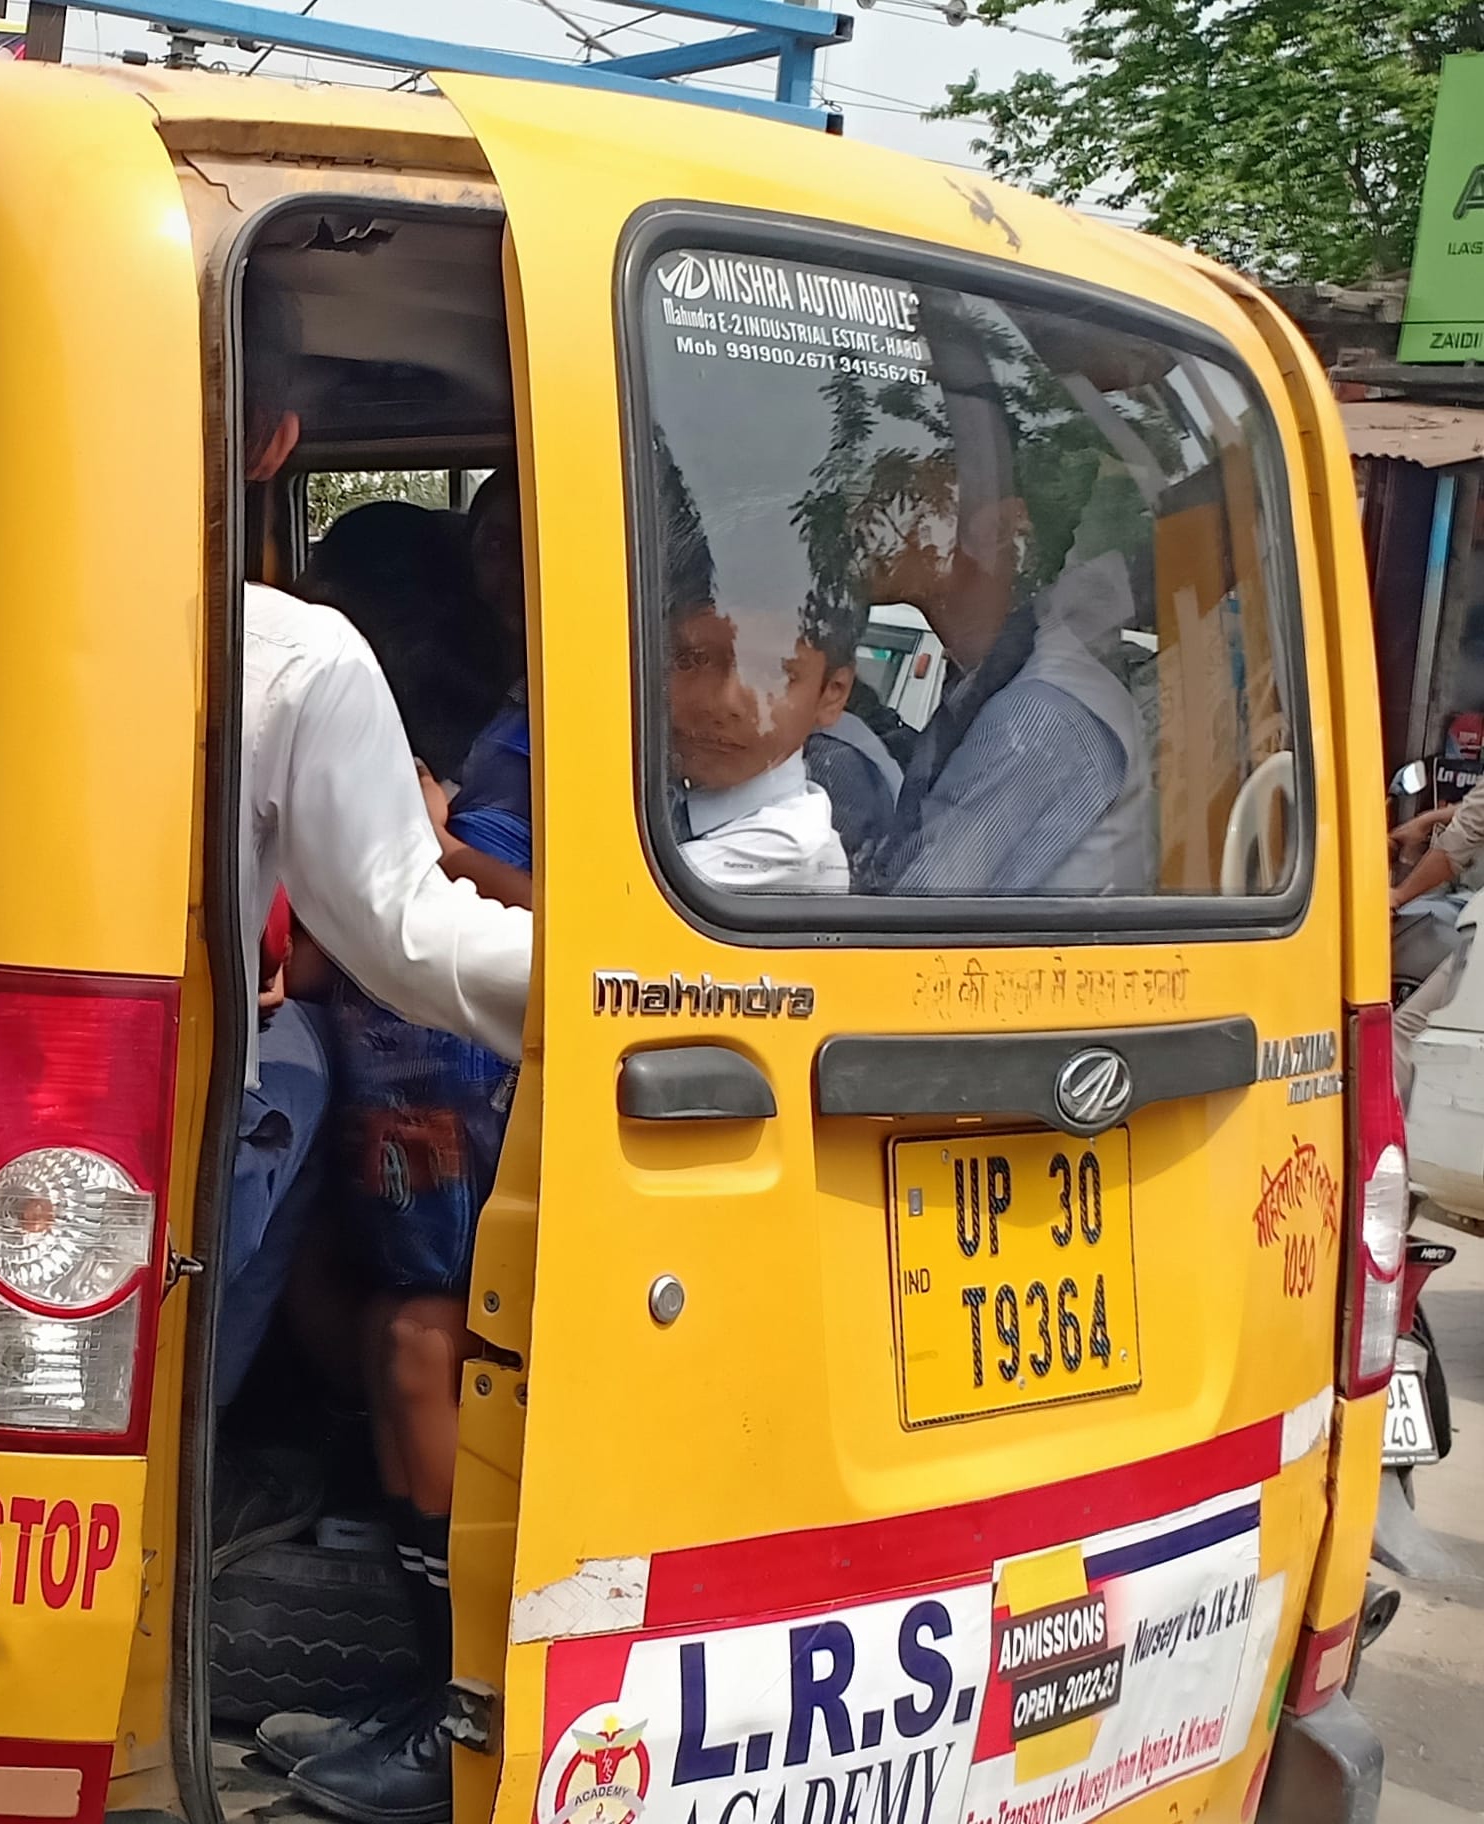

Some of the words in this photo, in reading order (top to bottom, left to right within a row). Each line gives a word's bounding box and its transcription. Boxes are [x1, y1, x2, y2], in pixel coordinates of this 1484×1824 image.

[662, 297, 717, 330] Mahindra
[708, 258, 794, 310] MISHRA
[592, 970, 816, 1020] Mahindra
[954, 1156, 1012, 1258] UP
[1048, 1150, 1103, 1248] 30
[903, 1268, 931, 1296] IND
[962, 1273, 1112, 1388] T9364
[997, 1602, 1107, 1674] ADMISSIONS
[1129, 1610, 1188, 1667] Nursery
[1186, 1601, 1207, 1643] to
[671, 1599, 977, 1788] L.R.S.
[1012, 1681, 1059, 1729] OPEN
[574, 1785, 630, 1806] ACADEMY
[681, 1741, 957, 1824] DEMY
